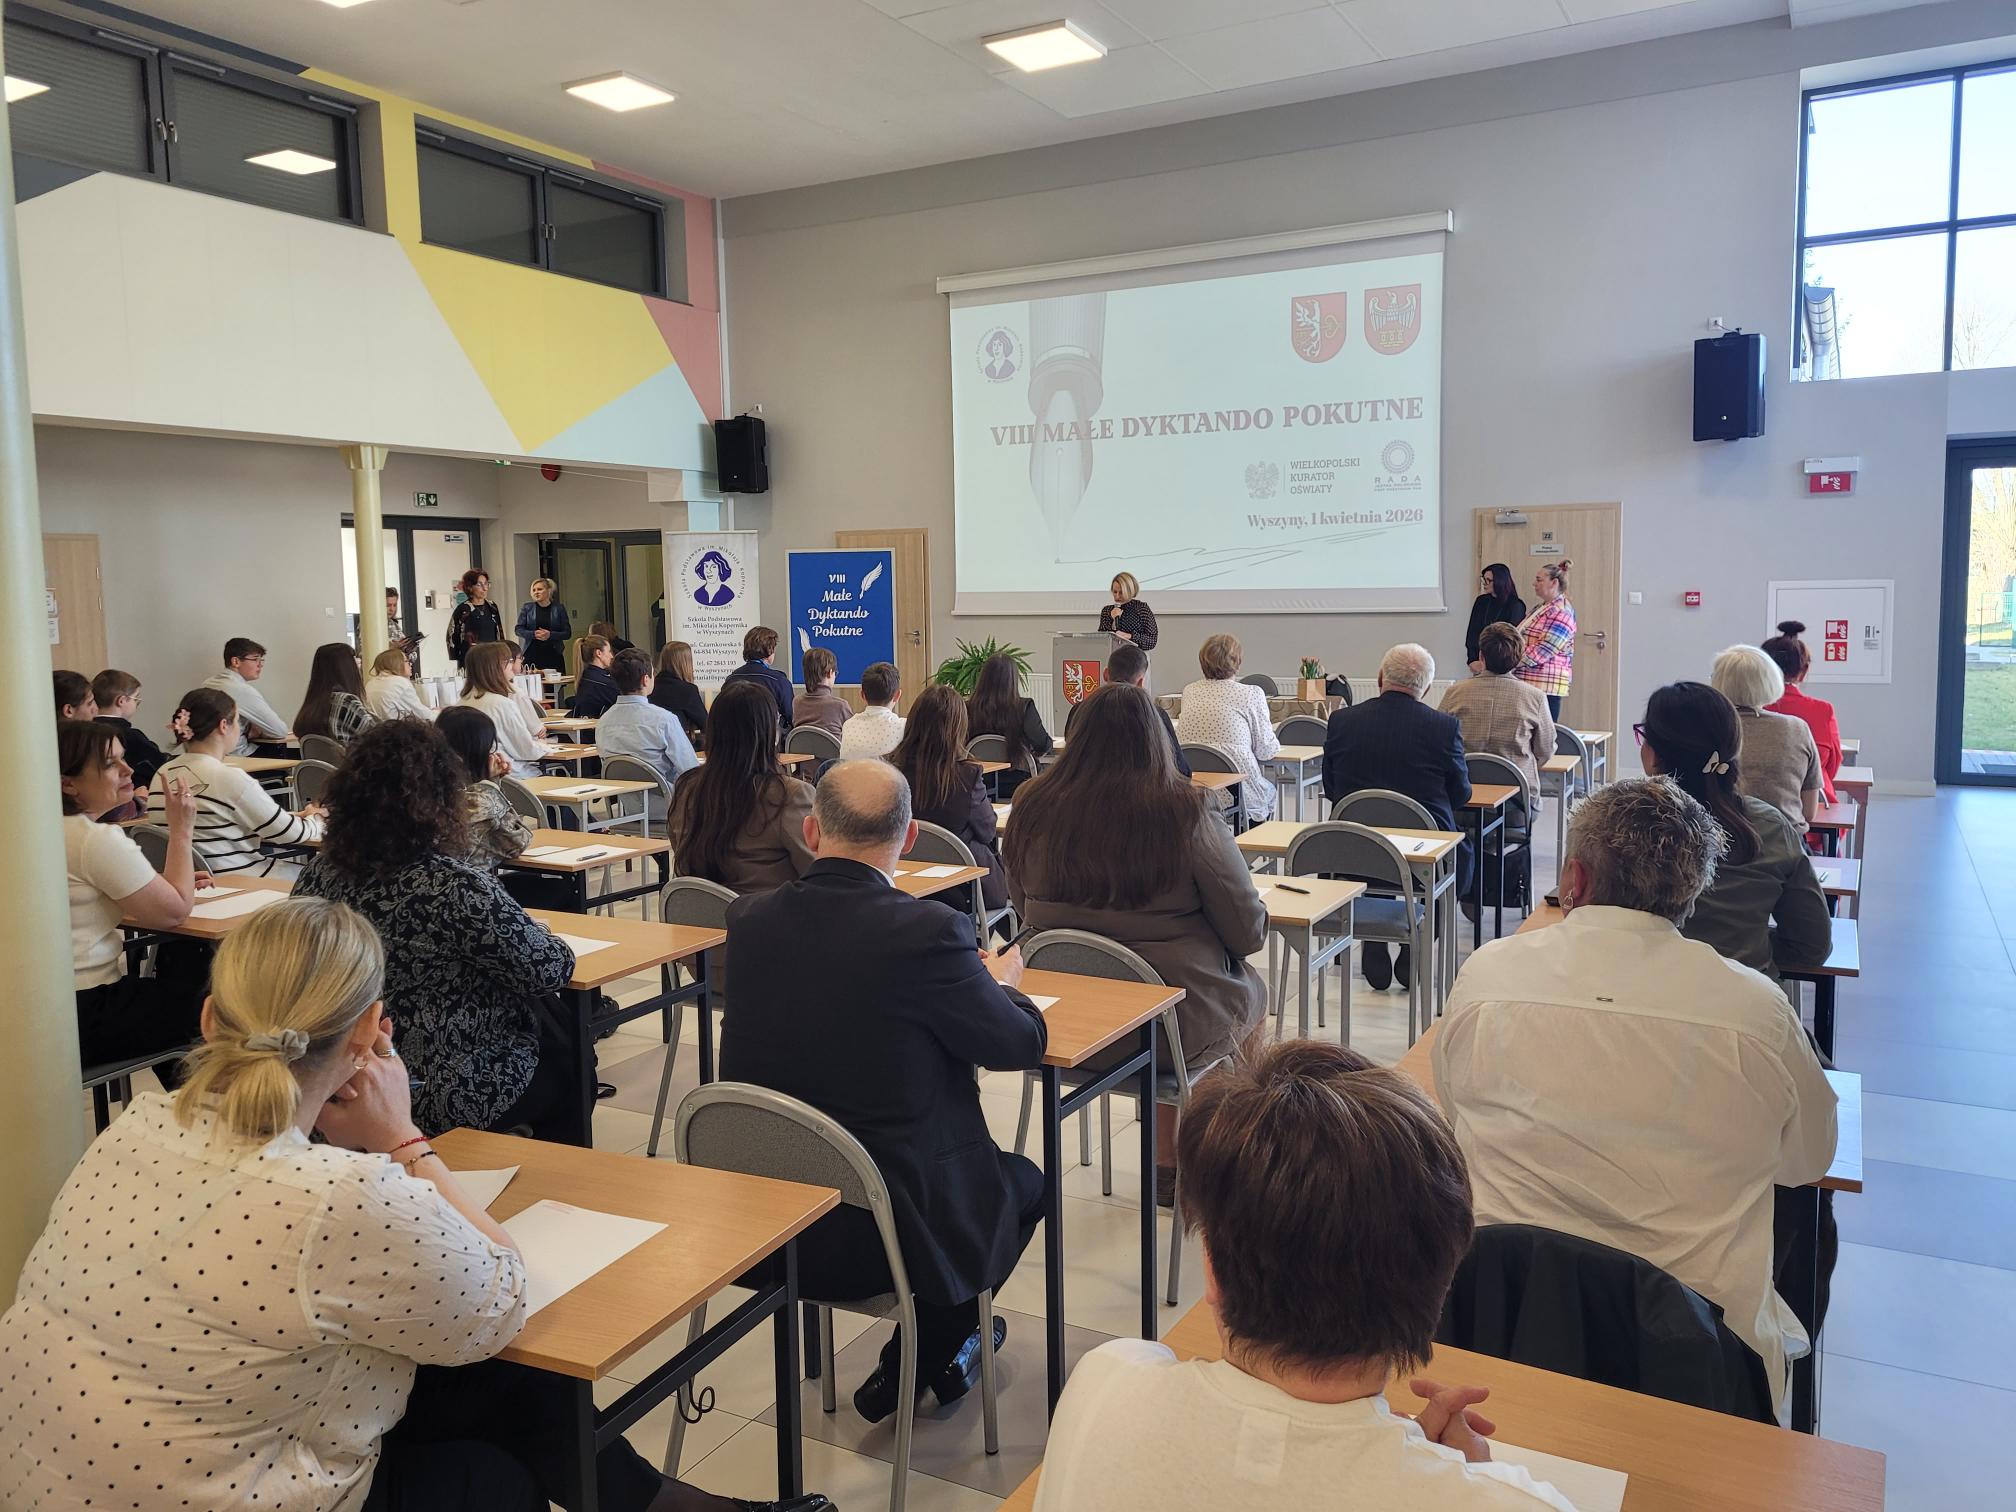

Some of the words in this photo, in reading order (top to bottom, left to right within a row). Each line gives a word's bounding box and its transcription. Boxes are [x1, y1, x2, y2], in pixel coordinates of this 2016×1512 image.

[991, 423, 1035, 446] VIII
[1043, 419, 1114, 443] MAŁE
[1121, 407, 1273, 438] DYKTANDO
[1283, 397, 1423, 428] POKUTNE
[1290, 457, 1360, 469] WIELKOPOLSKI
[1290, 471, 1335, 482] KURATOR
[1247, 514, 1308, 530] Wyszyny,
[1320, 510, 1382, 525] kwietnia
[1385, 508, 1423, 523] 2026
[828, 574, 846, 583] VIII
[807, 605, 869, 624] Dyktando
[812, 623, 864, 637] Pokutne
